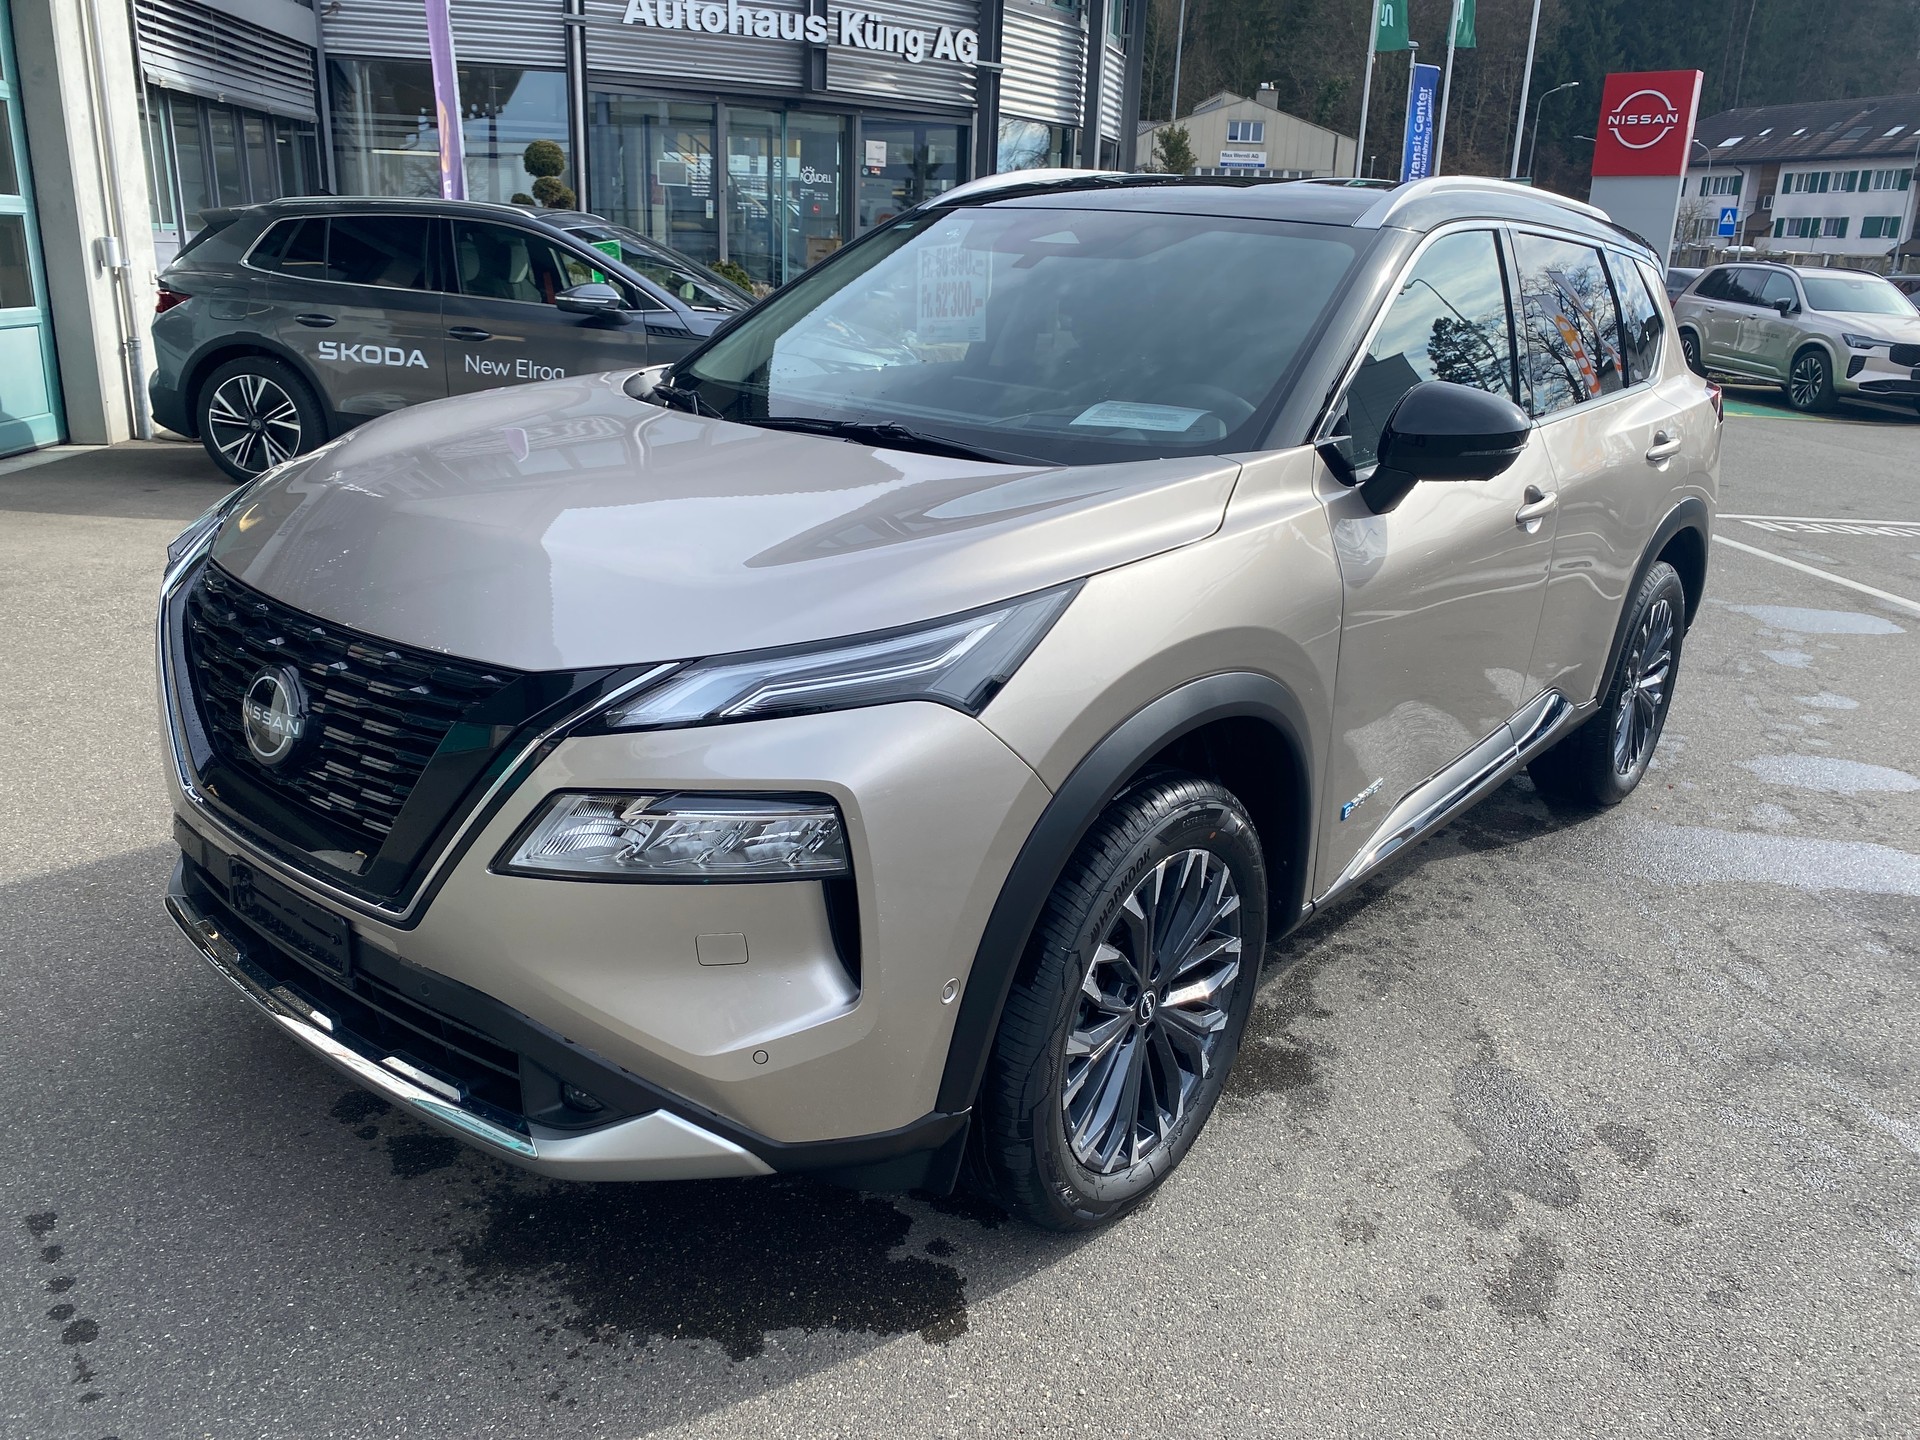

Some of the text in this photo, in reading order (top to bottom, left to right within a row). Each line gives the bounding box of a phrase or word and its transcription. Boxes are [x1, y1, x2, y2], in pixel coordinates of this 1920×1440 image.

[622, 0, 978, 64] Autohaus Küng AG
[1408, 86, 1429, 181] Transit Center
[1607, 113, 1679, 125] NISSAN
[465, 354, 510, 377] New
